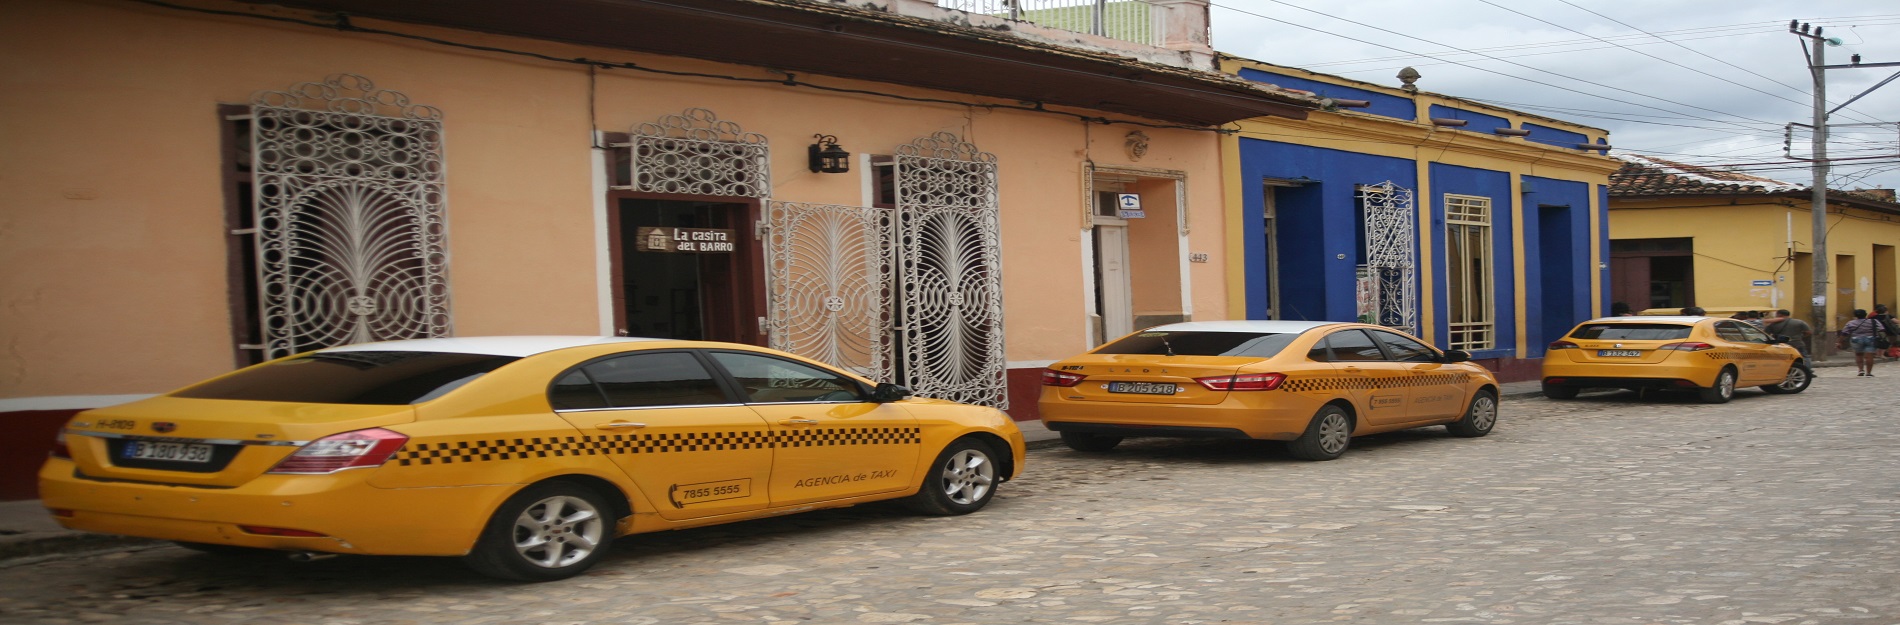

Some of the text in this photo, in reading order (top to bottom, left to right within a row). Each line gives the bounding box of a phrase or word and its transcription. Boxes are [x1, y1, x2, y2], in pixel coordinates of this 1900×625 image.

[674, 228, 688, 241] La
[700, 242, 733, 251] BARRO
[1118, 383, 1173, 394] B 205 618
[134, 442, 146, 457] B
[179, 446, 208, 461] 938
[794, 469, 897, 489] AGENCIA de TAXI
[683, 484, 740, 500] 7855 5555
